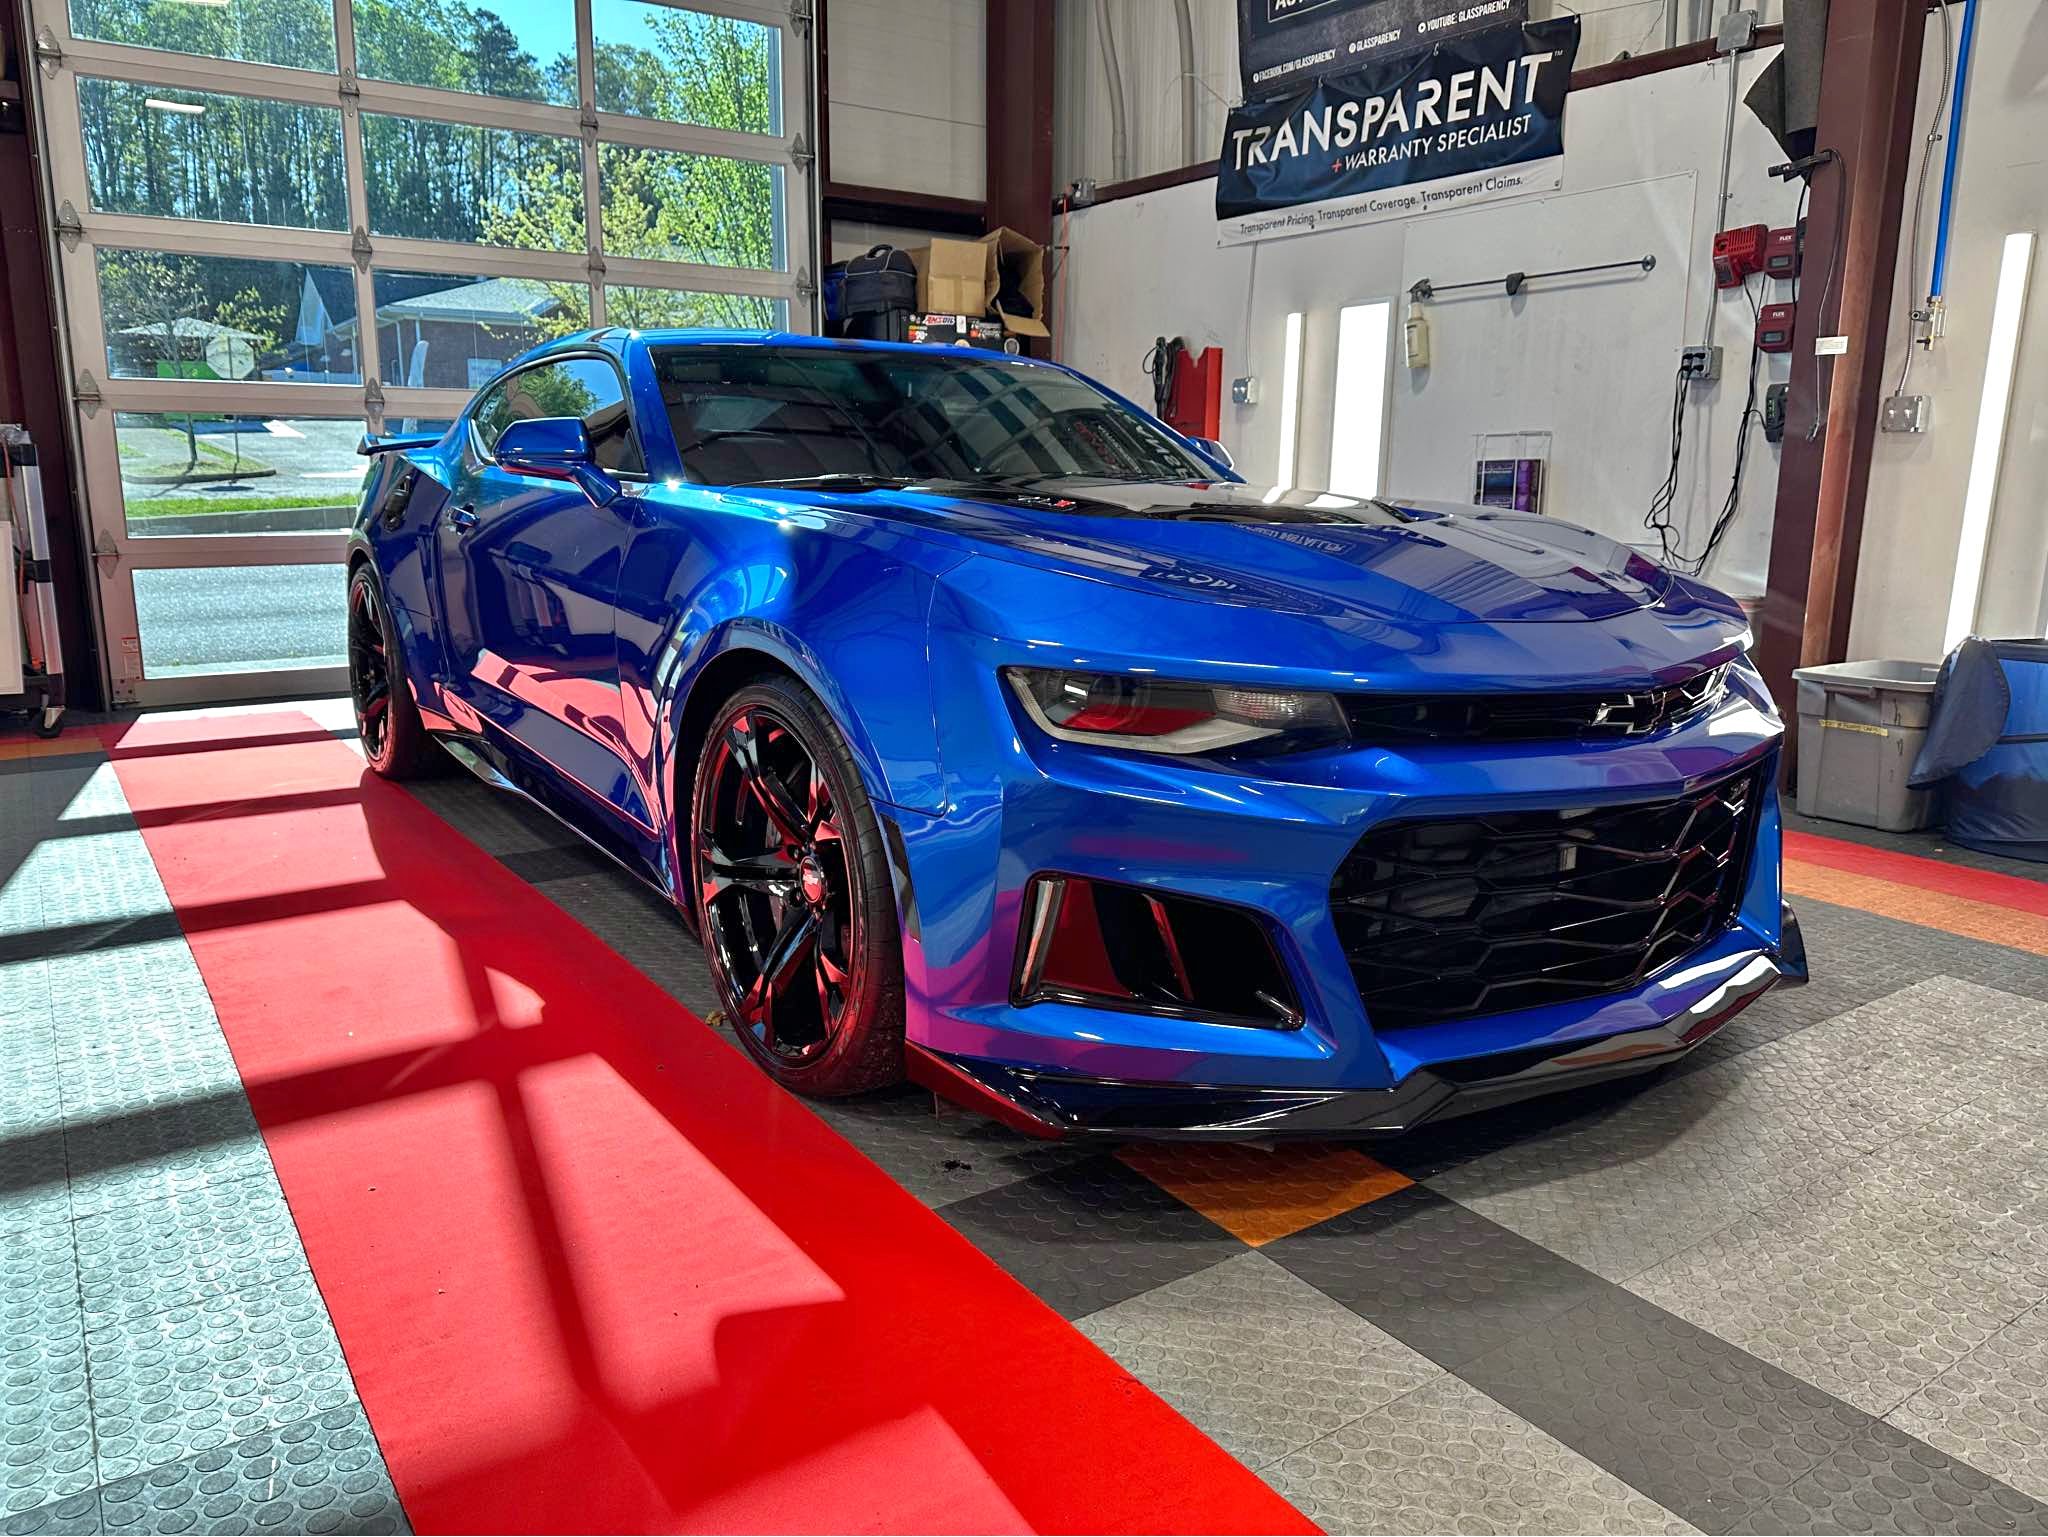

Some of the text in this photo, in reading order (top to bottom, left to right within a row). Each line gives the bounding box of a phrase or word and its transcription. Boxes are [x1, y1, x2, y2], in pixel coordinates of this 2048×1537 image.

[1427, 0, 1511, 32] YOUTUBE: GLASSPARENCY
[1356, 29, 1401, 52] GLASSPARENCY
[1259, 48, 1337, 81] FACEBOOK.COM/GLASSPARENCY
[1437, 114, 1532, 151] SPECIALIST
[1239, 174, 1523, 235] Transparent Pricing. Transparent Coverage. Transparent Claims.
